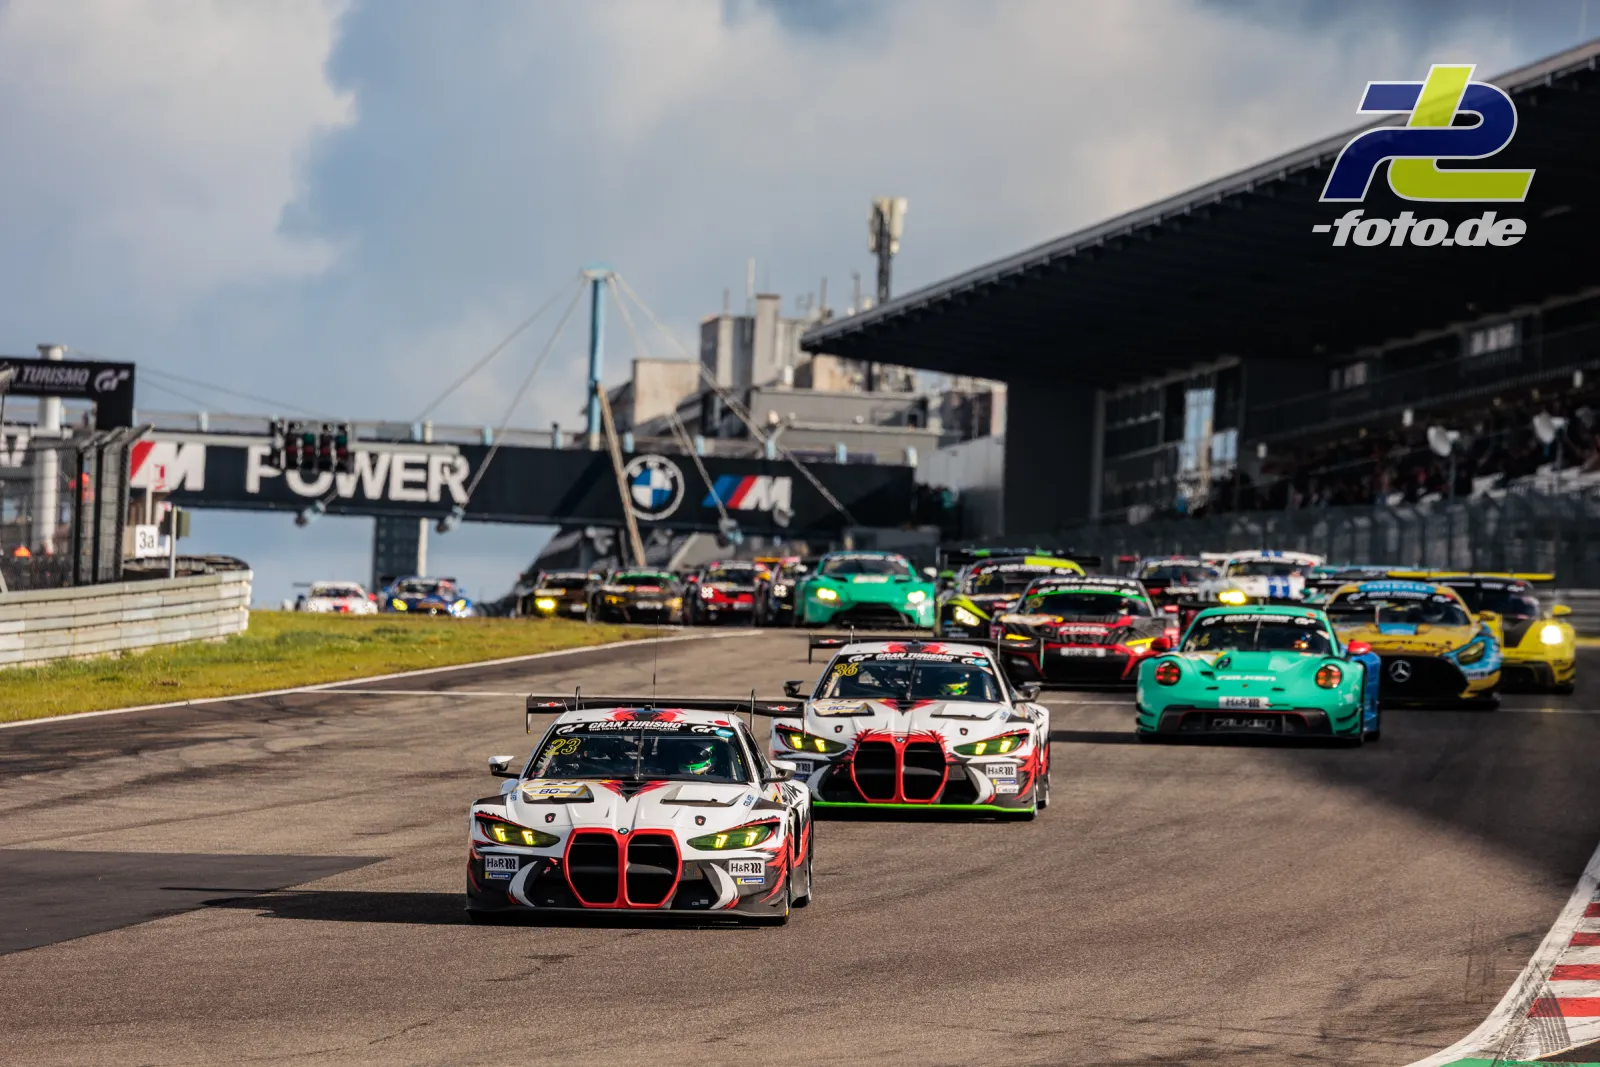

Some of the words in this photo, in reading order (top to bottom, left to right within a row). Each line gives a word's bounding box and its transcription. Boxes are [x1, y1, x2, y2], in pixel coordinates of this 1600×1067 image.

[22, 365, 90, 385] TURISMO
[246, 445, 470, 503] POWER
[139, 531, 155, 549] 3a
[907, 653, 954, 661] TURISMO
[834, 662, 859, 677] 36
[588, 721, 624, 729] GRAN
[626, 720, 682, 728] TURISMO
[546, 738, 582, 755] 23
[987, 766, 1004, 775] H&R
[487, 858, 505, 868] H&R
[731, 863, 750, 872] H&R
